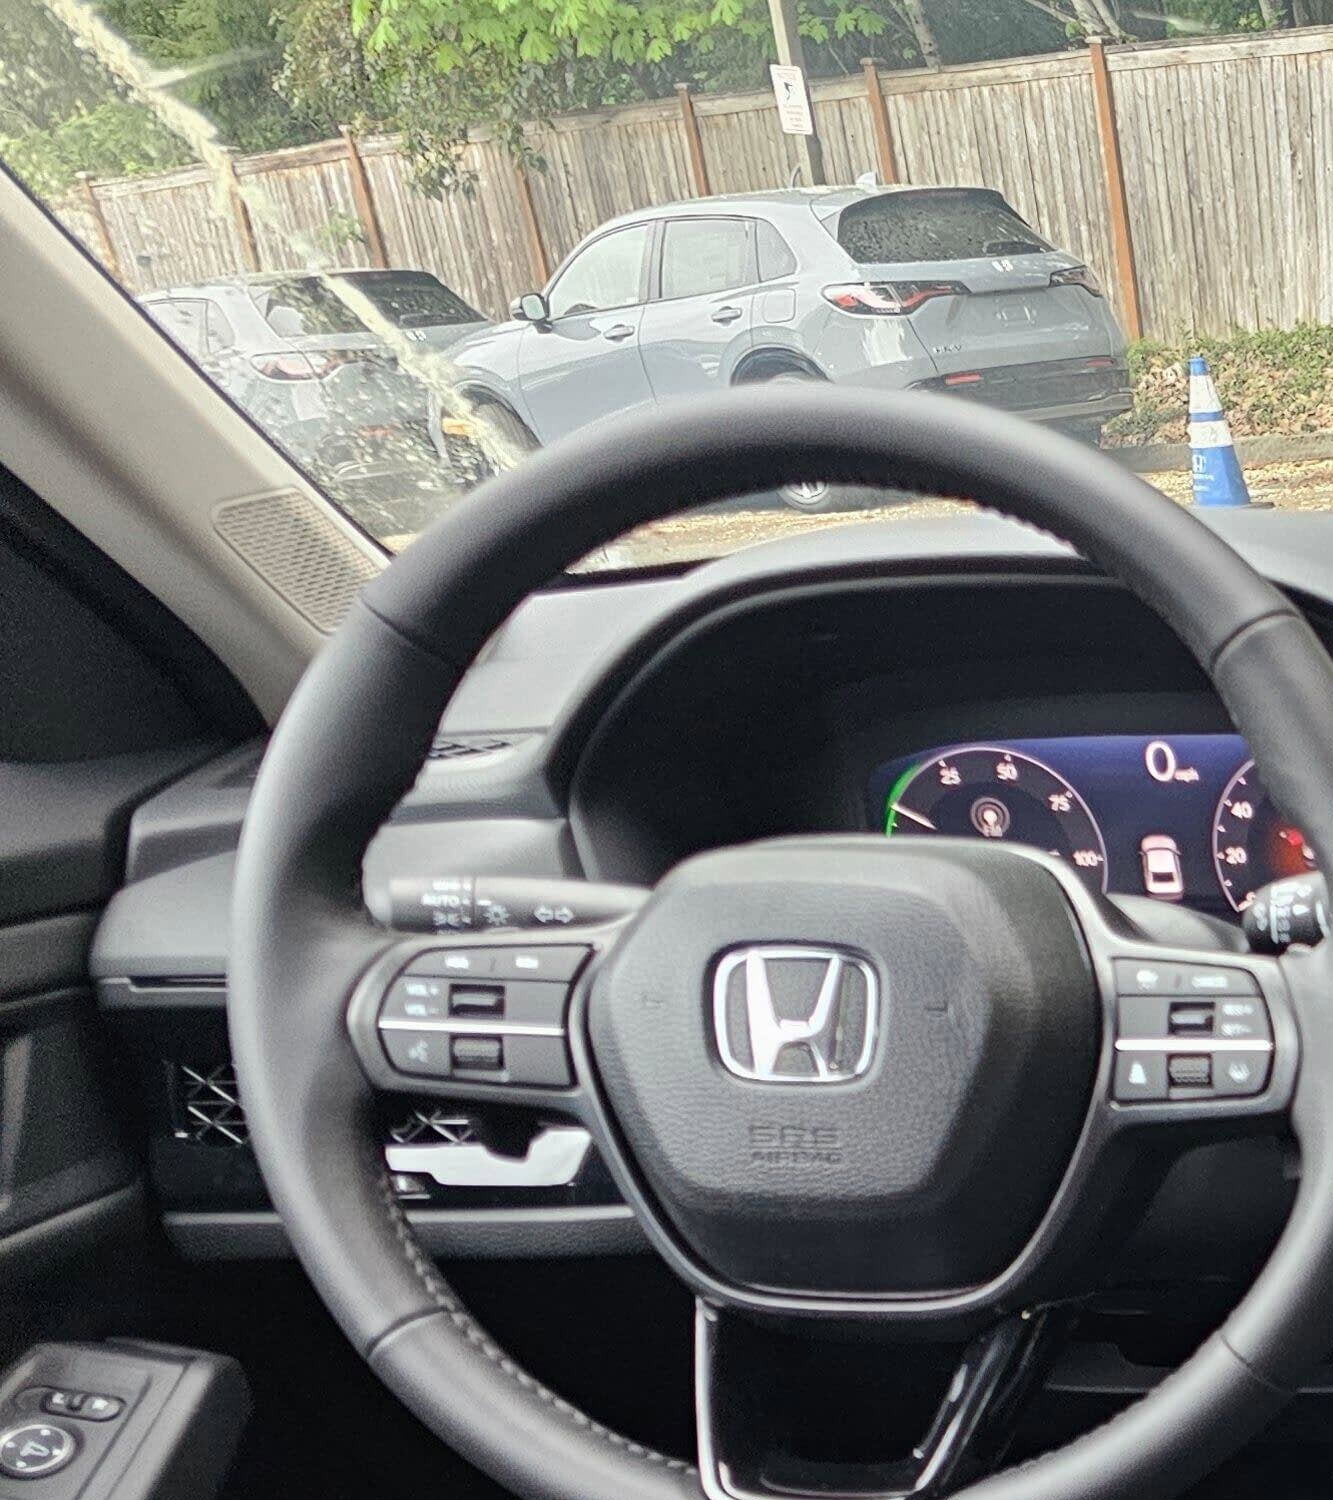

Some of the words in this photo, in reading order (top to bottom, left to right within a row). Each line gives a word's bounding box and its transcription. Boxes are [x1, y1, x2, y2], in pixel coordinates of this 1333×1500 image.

[1145, 740, 1176, 782] 0
[940, 767, 962, 785] 25
[996, 762, 1018, 780] 50
[1049, 794, 1071, 812] 75
[1231, 801, 1253, 819] 40
[1073, 850, 1099, 867] 100
[1225, 846, 1247, 865] 20
